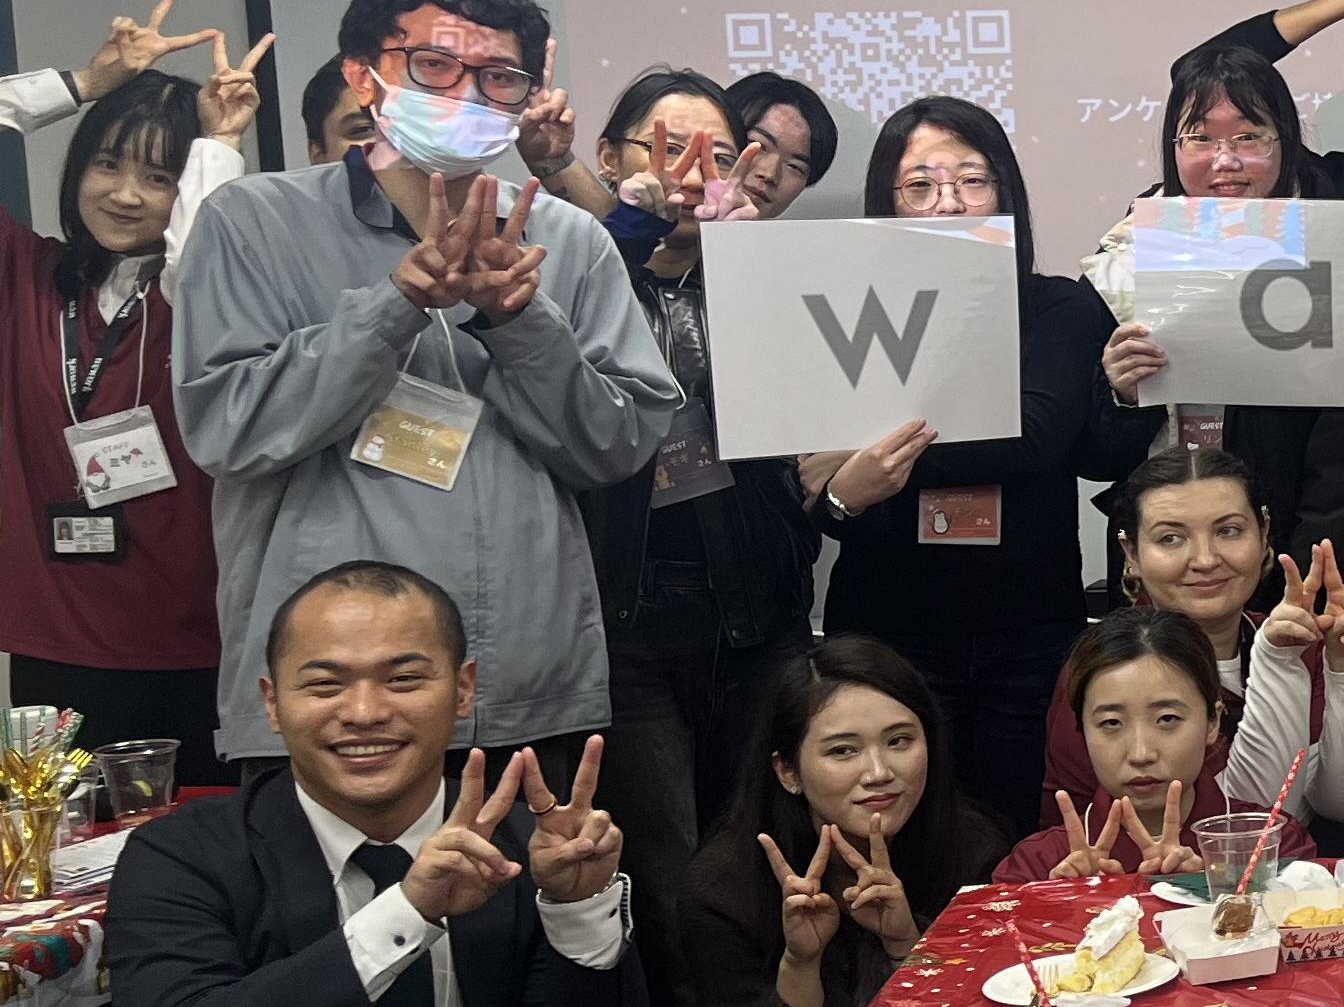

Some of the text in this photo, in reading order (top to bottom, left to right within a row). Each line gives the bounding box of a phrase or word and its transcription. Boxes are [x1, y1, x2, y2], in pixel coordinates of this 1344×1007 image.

[1240, 259, 1333, 351] a
[802, 285, 938, 389] w
[399, 420, 436, 437] GUEST
[101, 441, 130, 454] STAFF
[661, 440, 687, 454] GUEST
